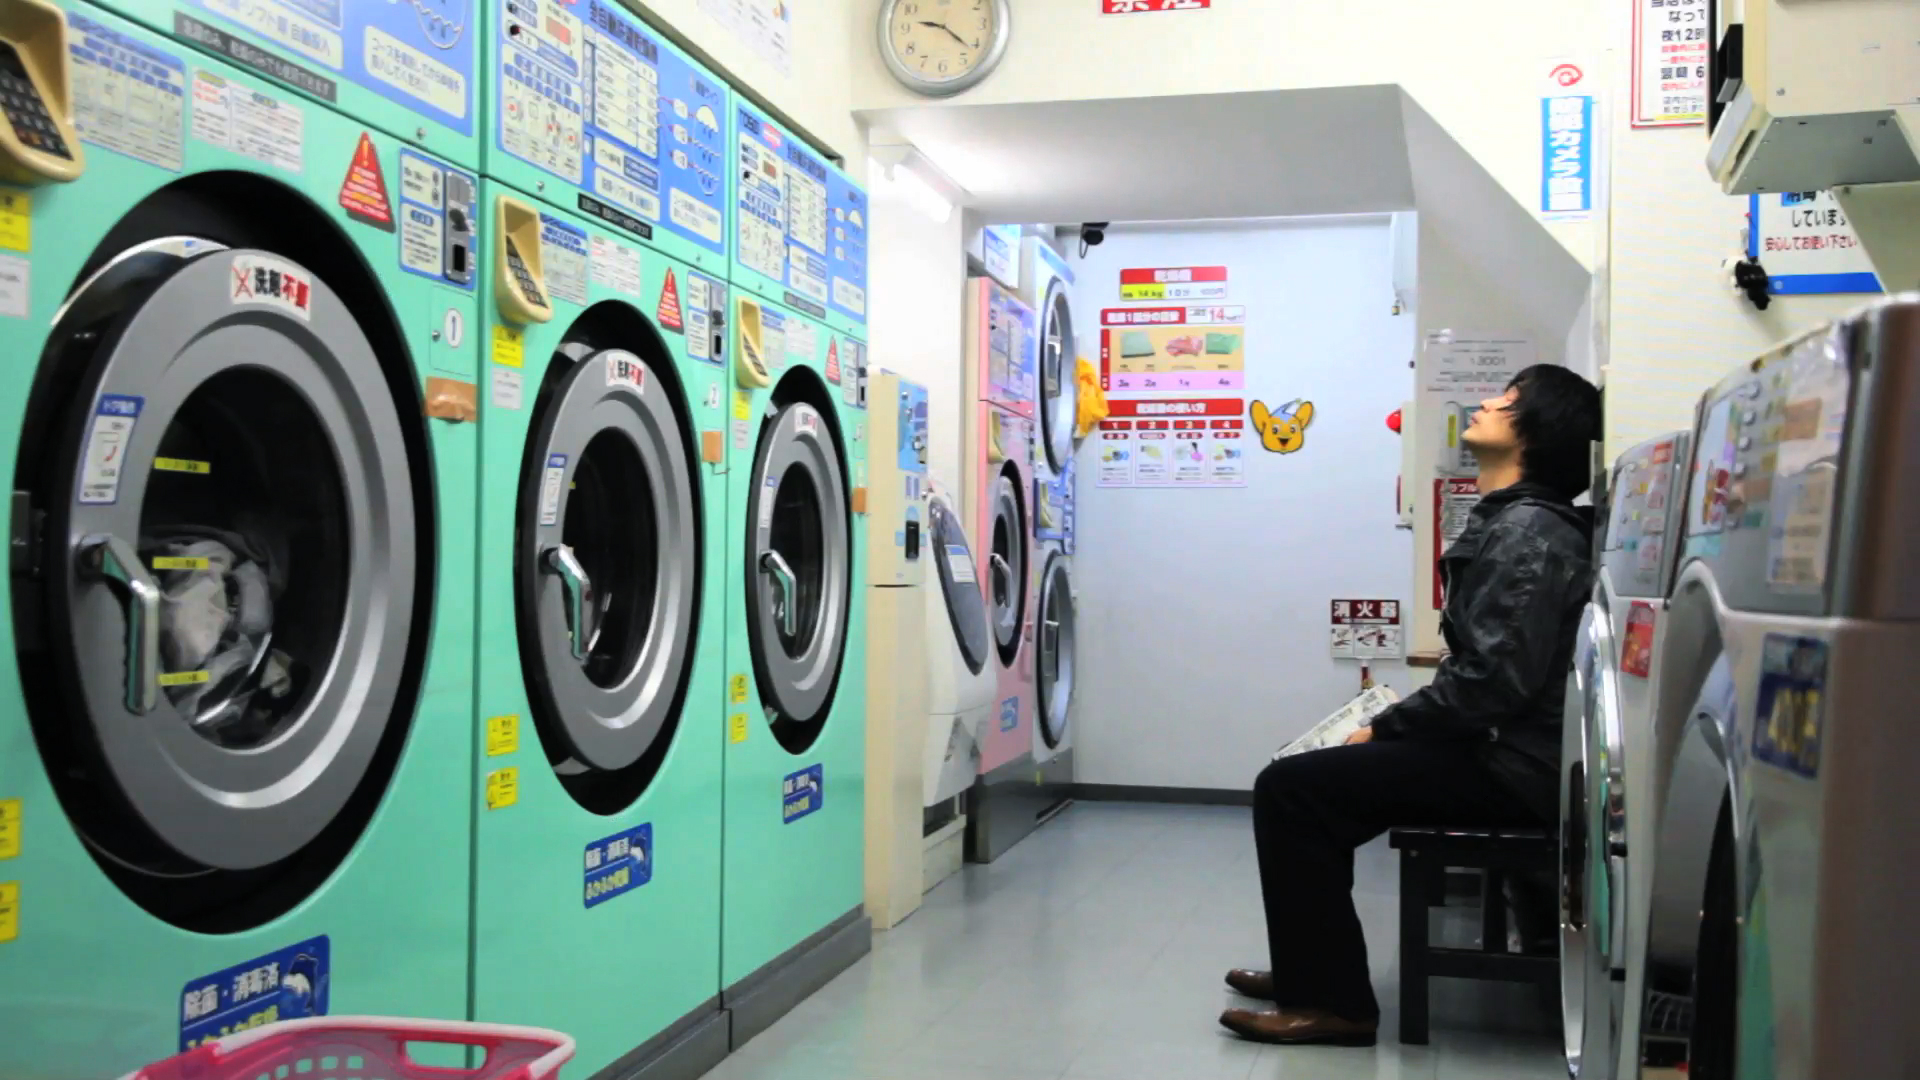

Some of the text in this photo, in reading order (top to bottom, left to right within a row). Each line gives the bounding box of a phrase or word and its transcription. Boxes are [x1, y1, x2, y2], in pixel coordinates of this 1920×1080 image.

[902, 3, 918, 15] 10
[901, 22, 910, 35] 9
[977, 17, 987, 31] 3
[906, 42, 915, 55] 8
[970, 37, 980, 49] 4
[919, 55, 929, 68] 7
[959, 52, 968, 66] 5
[938, 60, 947, 73] 6
[1765, 234, 1857, 252] 安心してお使い下さい
[1210, 308, 1225, 322] 14
[1333, 601, 1397, 618] 消火器
